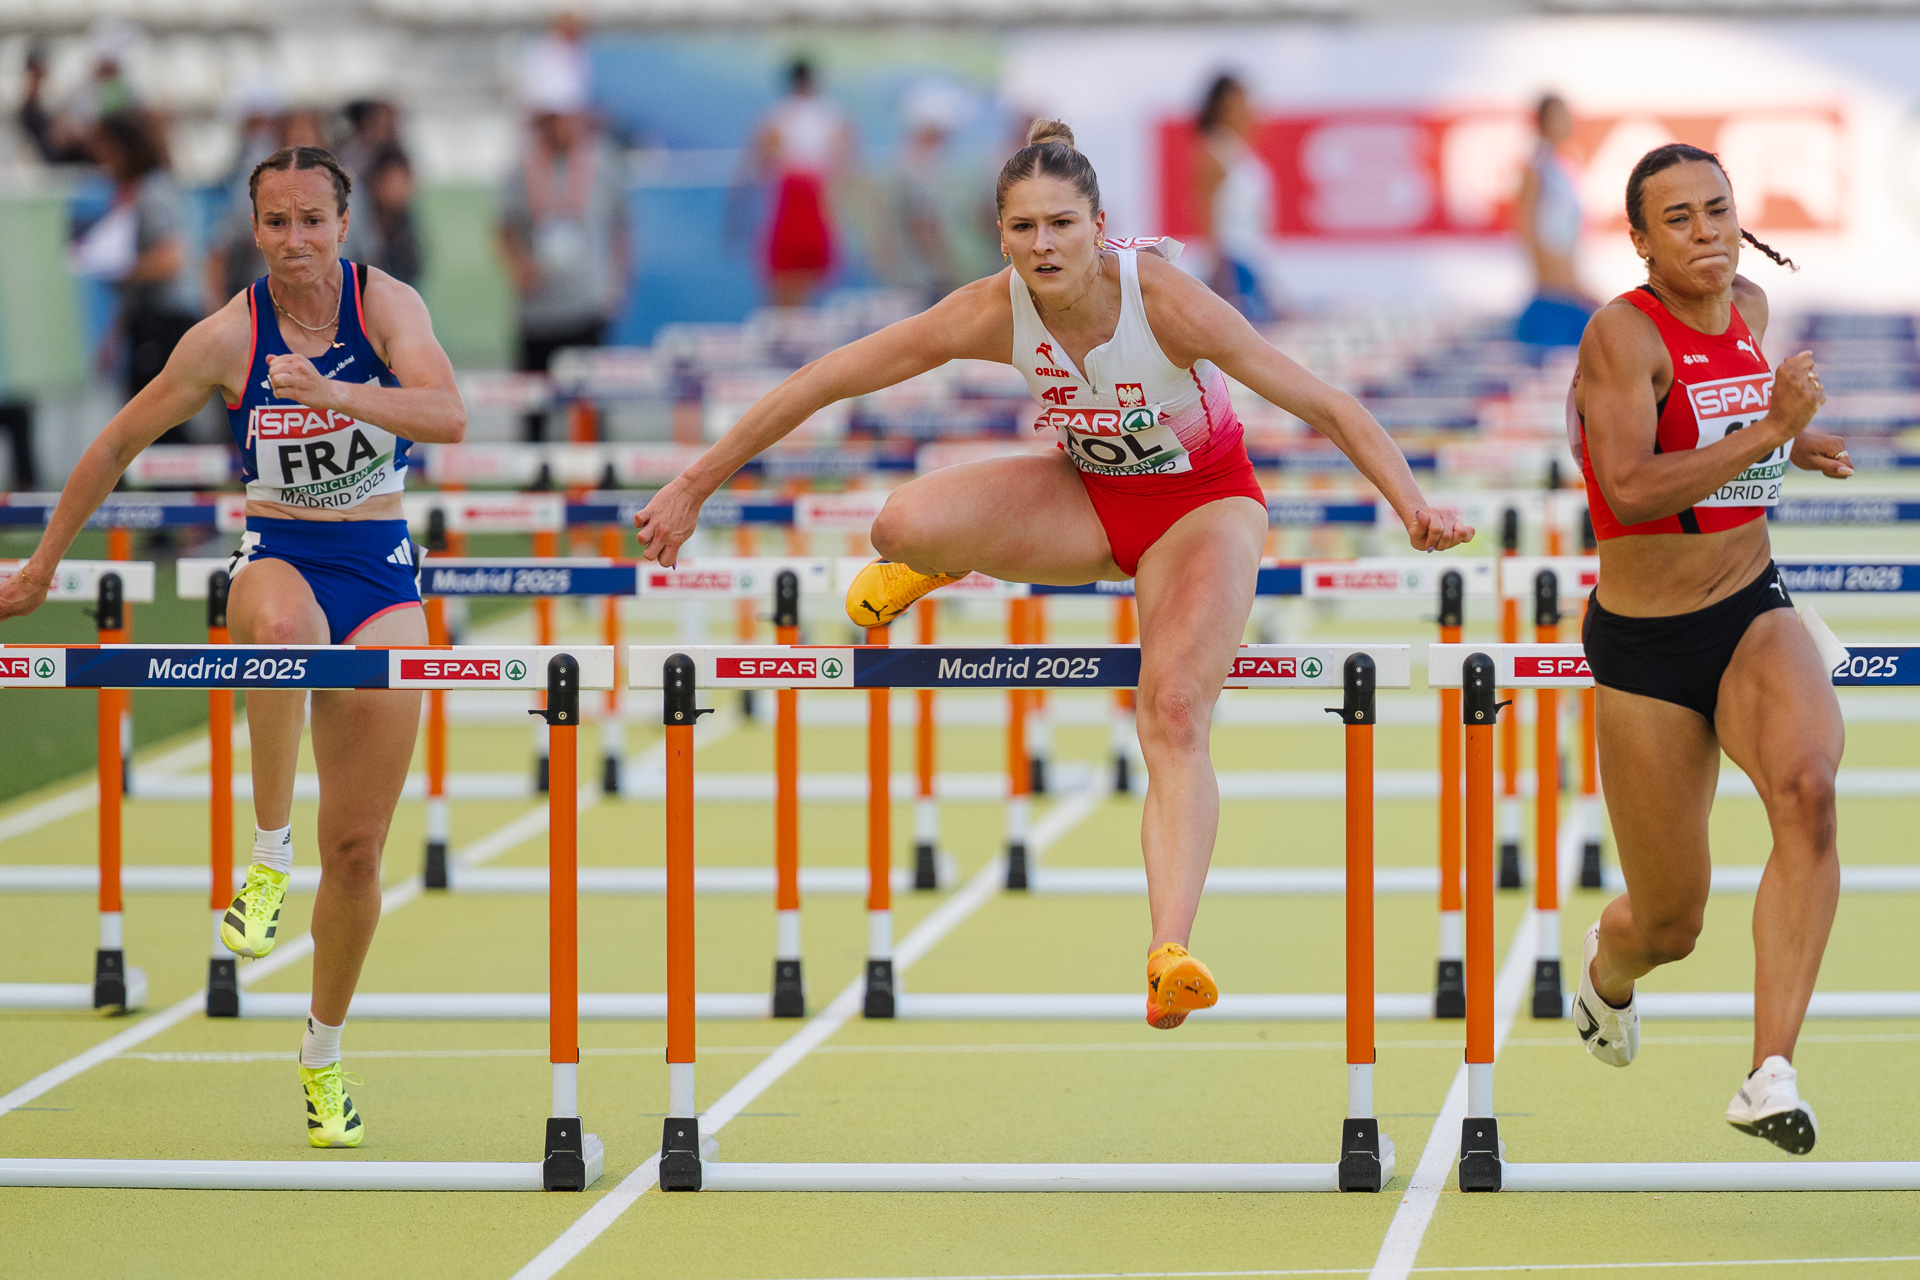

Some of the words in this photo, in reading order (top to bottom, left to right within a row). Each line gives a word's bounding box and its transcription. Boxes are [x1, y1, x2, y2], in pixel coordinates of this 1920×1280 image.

[1035, 367, 1070, 378] ORLEN
[278, 429, 378, 484] FRA
[280, 489, 352, 508] MADRID
[355, 467, 386, 500] 2025
[1704, 484, 1764, 500] ADRID
[1779, 565, 1844, 590] adrid
[148, 657, 238, 680] Madrid
[242, 658, 308, 680] 2025
[423, 662, 499, 677] SPAR
[739, 660, 815, 675] SPAR
[937, 656, 1030, 679] Madrid
[1035, 657, 1101, 679] 2025
[1537, 659, 1592, 674] SPA
[1833, 656, 1899, 678] 2025
